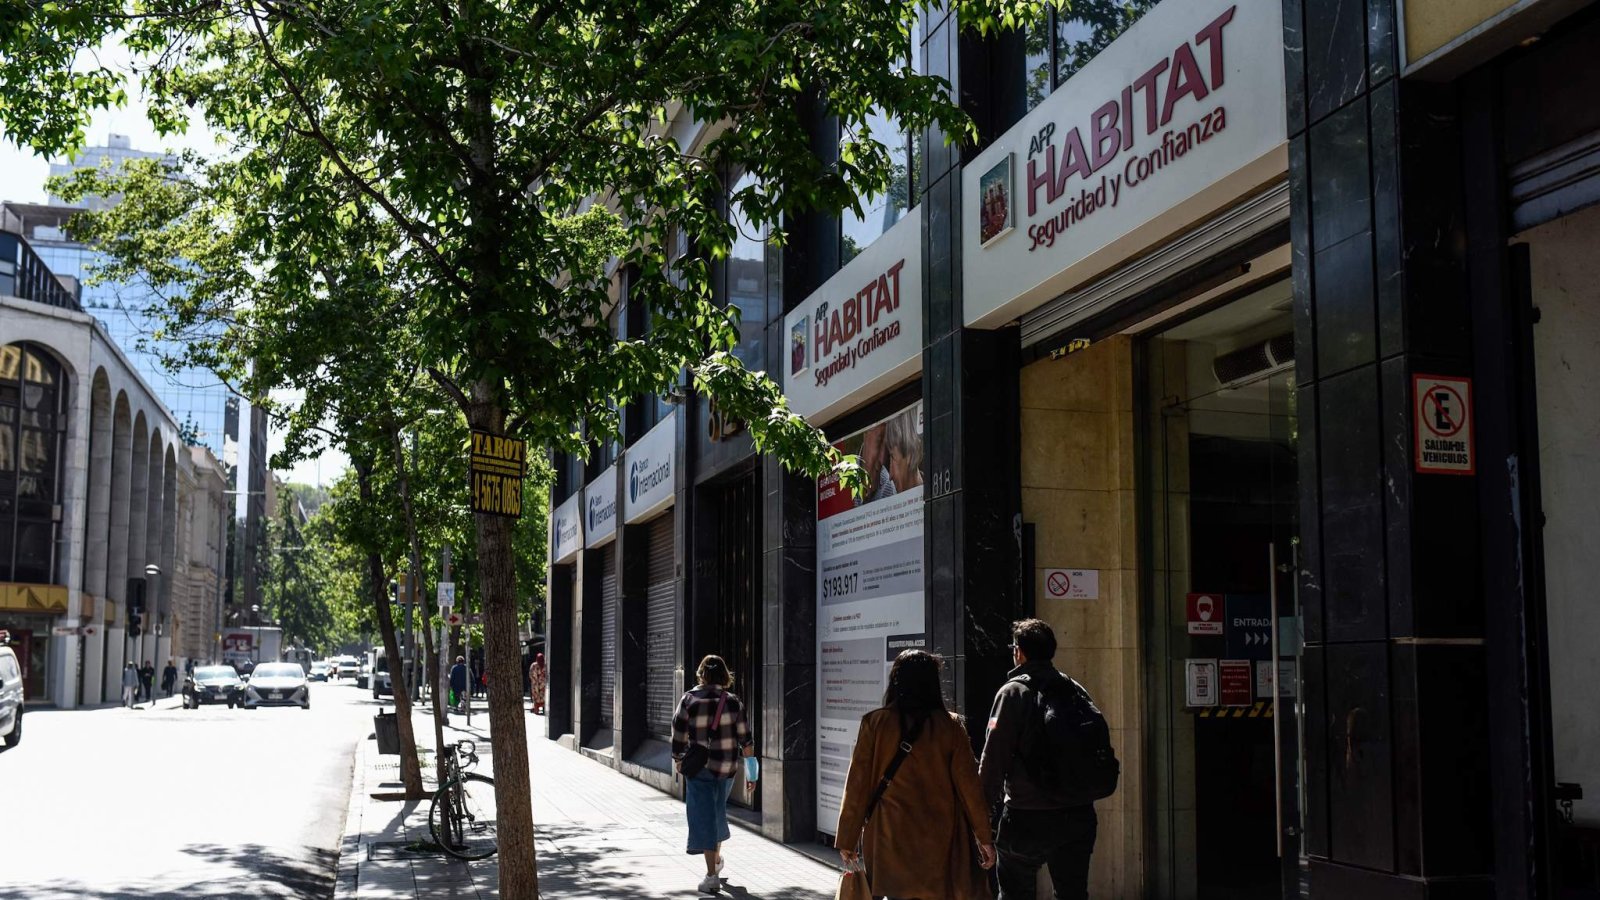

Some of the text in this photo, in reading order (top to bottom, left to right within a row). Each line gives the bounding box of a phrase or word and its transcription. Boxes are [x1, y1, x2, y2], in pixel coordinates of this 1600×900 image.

[1026, 4, 1236, 217] HABITAT
[1027, 121, 1055, 160] AFP
[1028, 106, 1226, 251] Seguridad y Confianza
[815, 258, 905, 363] HABITAT
[815, 301, 828, 324] AFP
[814, 320, 900, 387] Seguridad y Confianza
[473, 432, 522, 461] TAROT
[1423, 451, 1468, 465] VEHICULOS
[474, 472, 480, 510] 9
[933, 469, 951, 496] 818
[595, 499, 616, 527] Internaciona
[823, 572, 858, 599] $193.917
